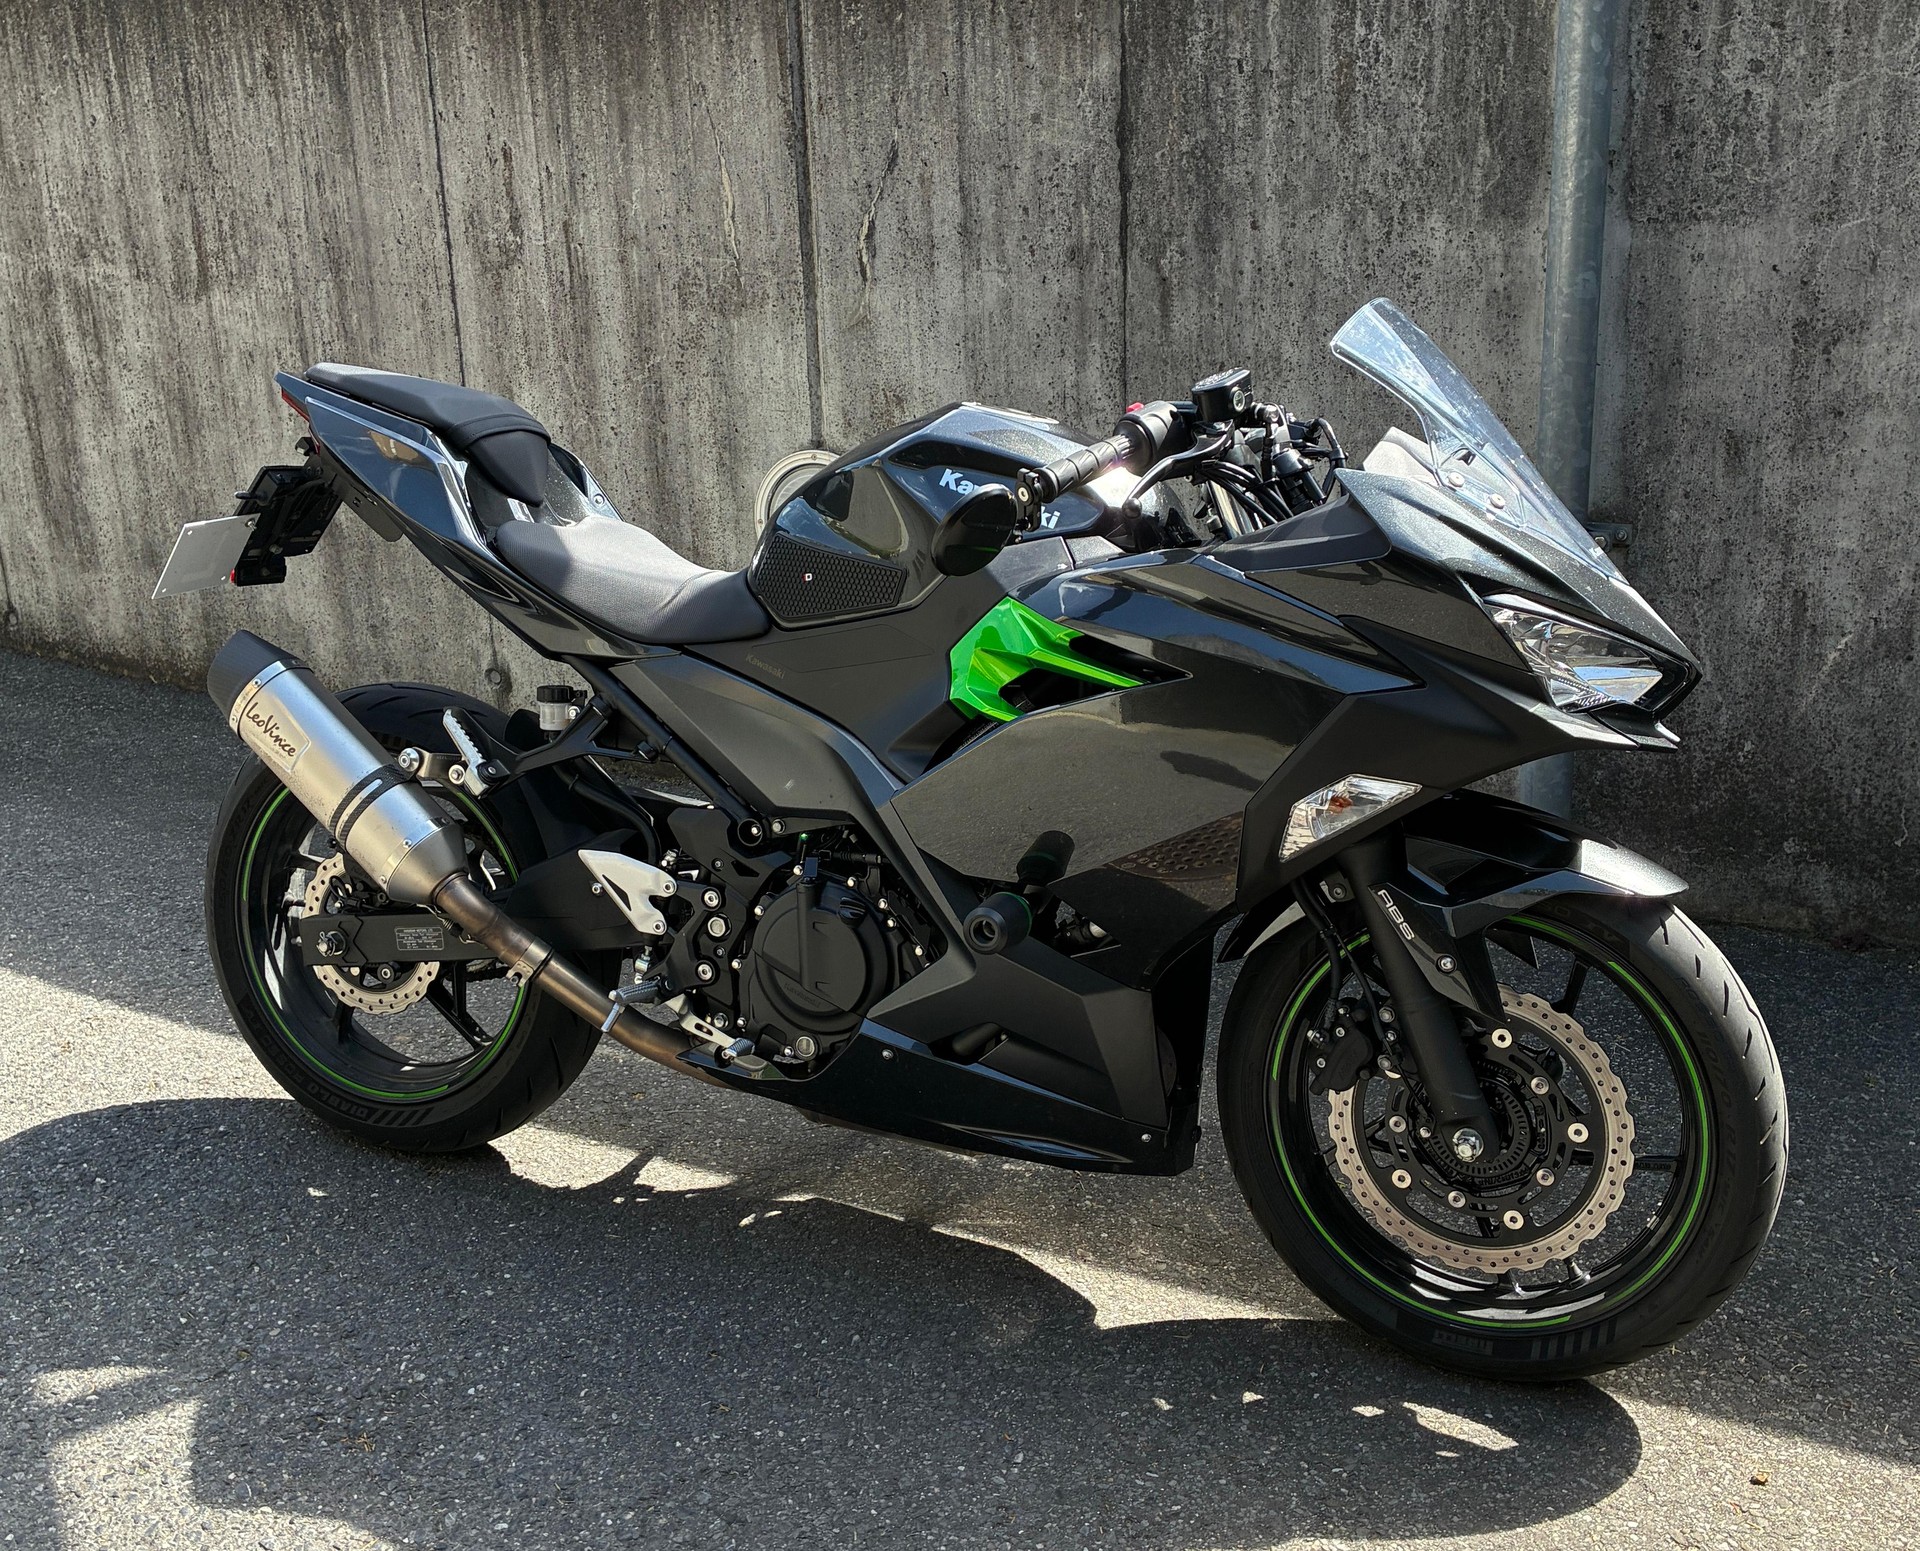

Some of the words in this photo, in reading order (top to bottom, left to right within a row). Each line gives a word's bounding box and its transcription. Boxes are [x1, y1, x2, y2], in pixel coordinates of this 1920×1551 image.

[939, 468, 1061, 530] Kaki
[745, 653, 786, 679] Kawasaki
[246, 702, 296, 757] LeoVince
[1377, 889, 1415, 940] ABS
